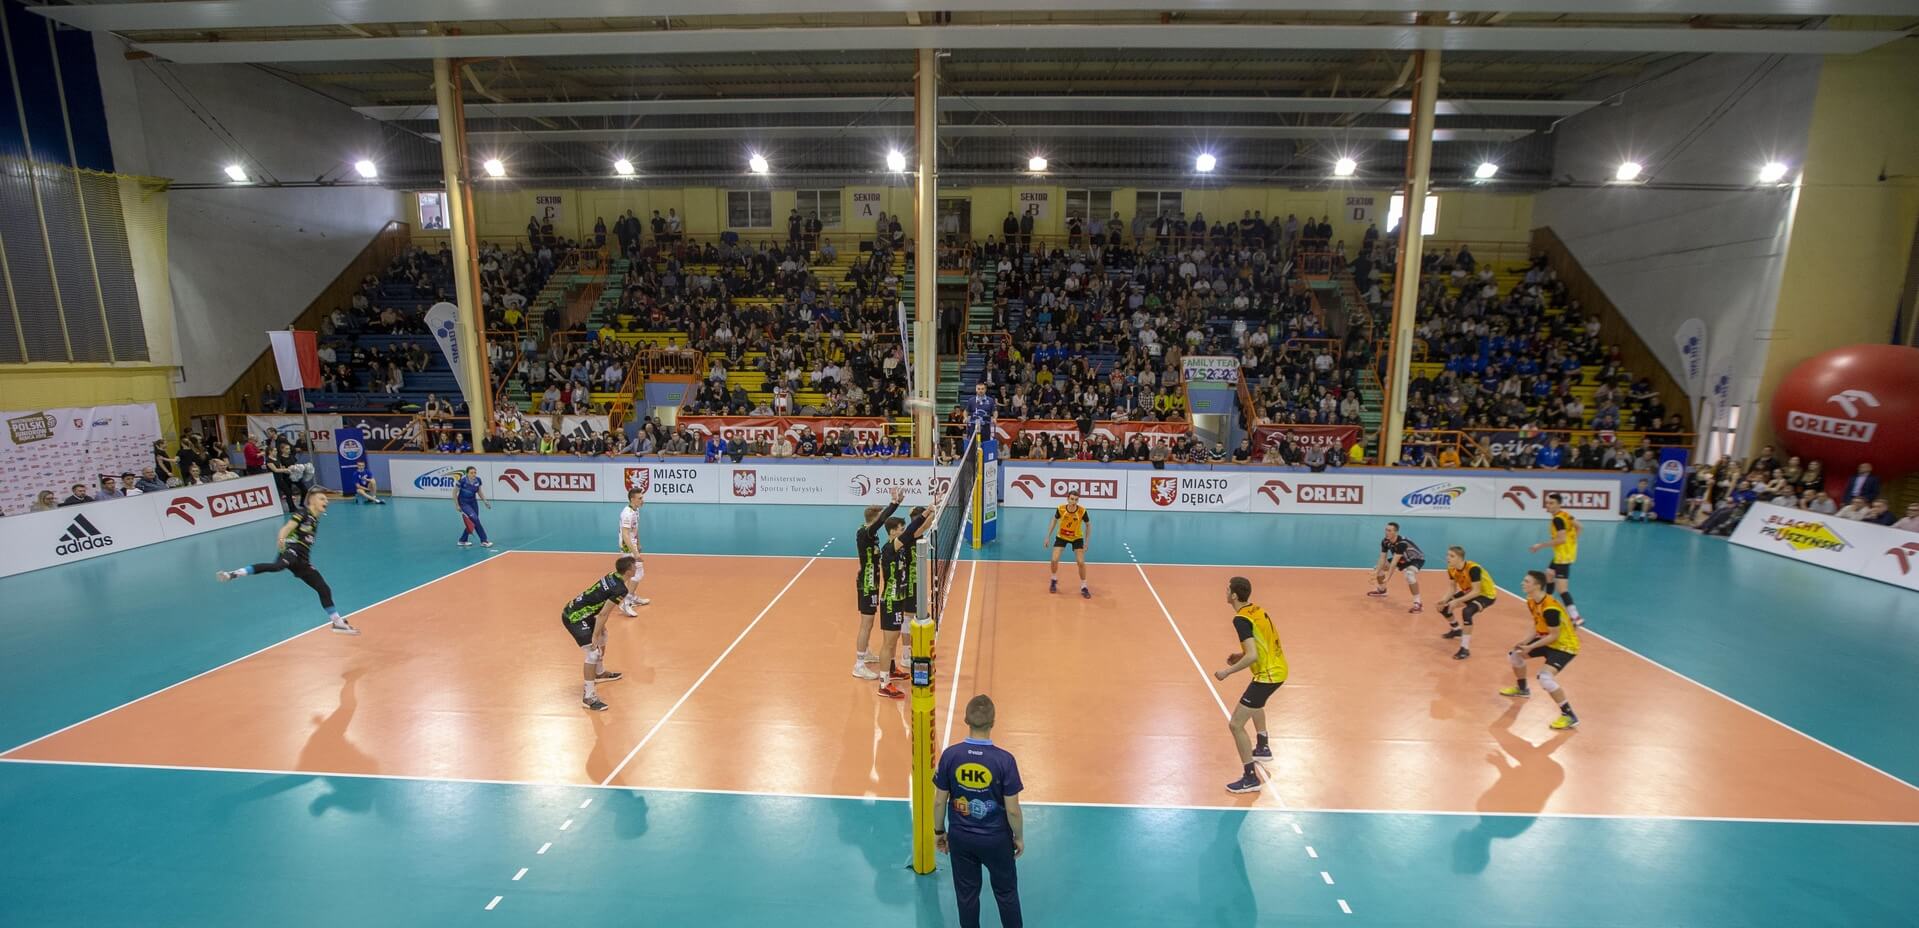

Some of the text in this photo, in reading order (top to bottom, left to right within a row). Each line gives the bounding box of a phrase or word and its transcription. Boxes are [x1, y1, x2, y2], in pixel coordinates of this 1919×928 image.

[1020, 193, 1047, 201] SEKTOR
[545, 206, 554, 218] C
[863, 204, 872, 216] A
[1029, 203, 1039, 216] B
[12, 420, 46, 432] POLSKI
[1793, 415, 1868, 438] ORLEN
[654, 469, 697, 479] MIASTO
[760, 475, 807, 483] Ministerstwo
[537, 476, 592, 490] ORLEN
[876, 477, 922, 486] POLSKA
[1181, 478, 1228, 490] MIASTO
[654, 483, 694, 496] DĘBICA
[1053, 481, 1114, 497] ORLEN
[1300, 485, 1361, 503] ORLEN
[214, 488, 269, 515] ORLEN
[1181, 492, 1224, 506] DĘBICA
[56, 533, 114, 557] adidas
[961, 769, 986, 783] HK
